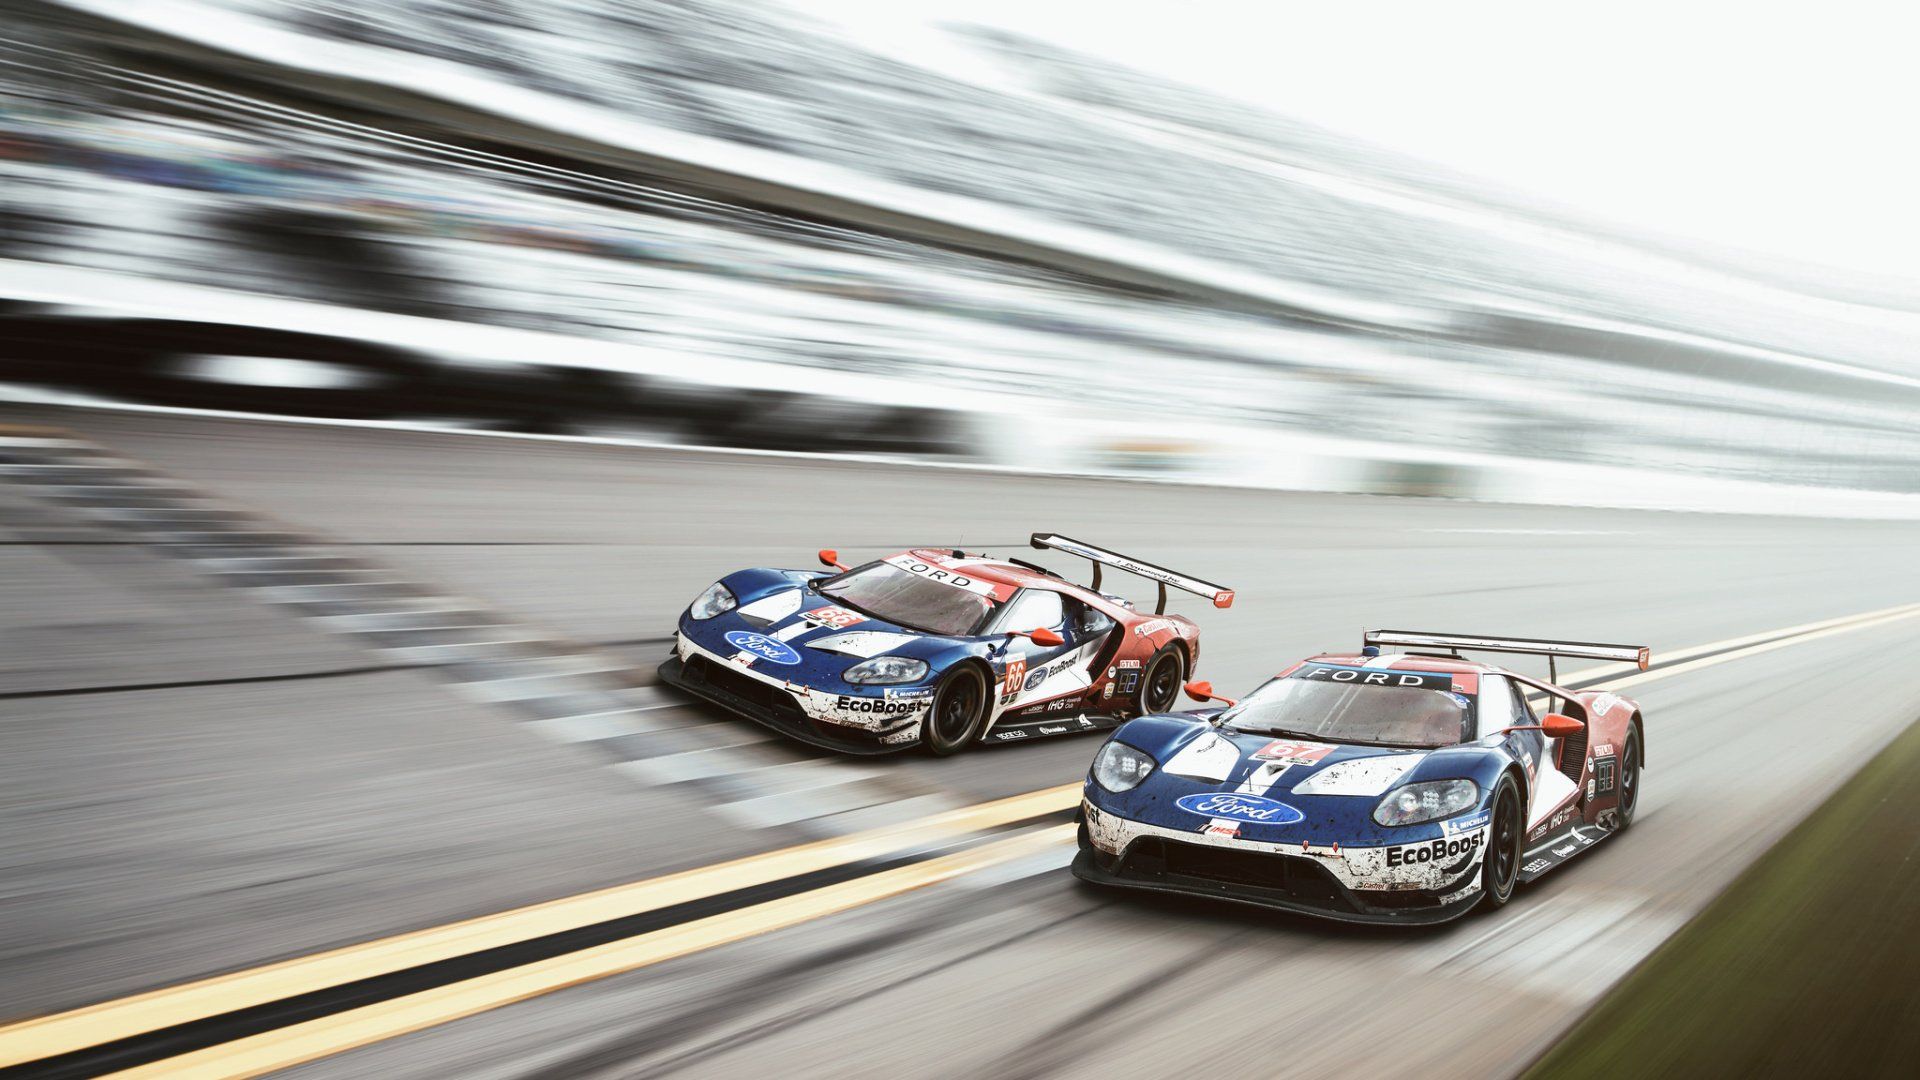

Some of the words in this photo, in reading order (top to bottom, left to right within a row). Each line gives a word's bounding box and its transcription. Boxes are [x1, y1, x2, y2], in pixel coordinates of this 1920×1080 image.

[898, 558, 972, 587] FORD
[816, 607, 858, 624] 66
[735, 635, 788, 658] Ford
[1047, 653, 1079, 679] EcoBoost
[1006, 662, 1024, 693] 66
[1307, 668, 1424, 687] FORD
[837, 696, 923, 713] EcoBoost
[1048, 699, 1065, 711] IHG
[1269, 744, 1325, 758] 67
[1196, 795, 1281, 820] Ford
[1459, 814, 1489, 830] MICHELIN
[1386, 828, 1485, 868] EcoBoost
